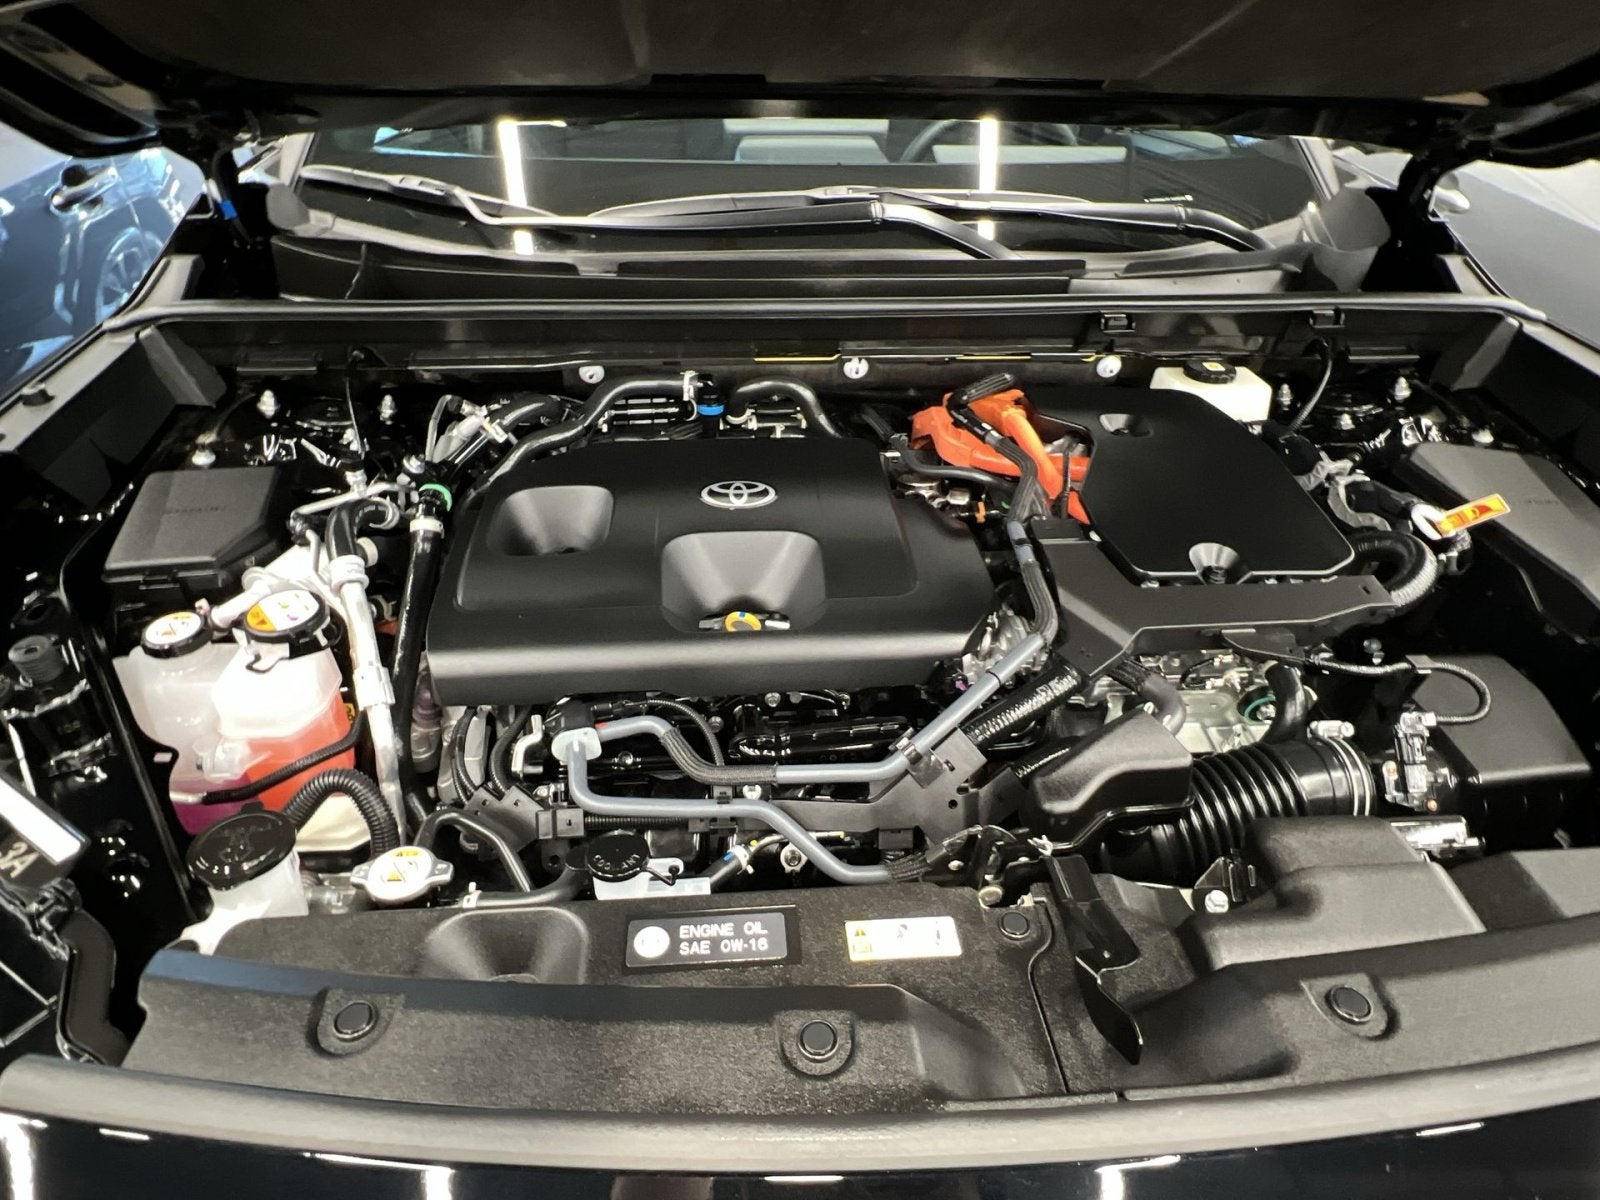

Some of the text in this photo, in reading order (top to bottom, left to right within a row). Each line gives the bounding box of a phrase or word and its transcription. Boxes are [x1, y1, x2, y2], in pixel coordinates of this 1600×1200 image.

[679, 920, 769, 939] ENGINE OIL
[679, 937, 769, 955] SAE 0W-16
